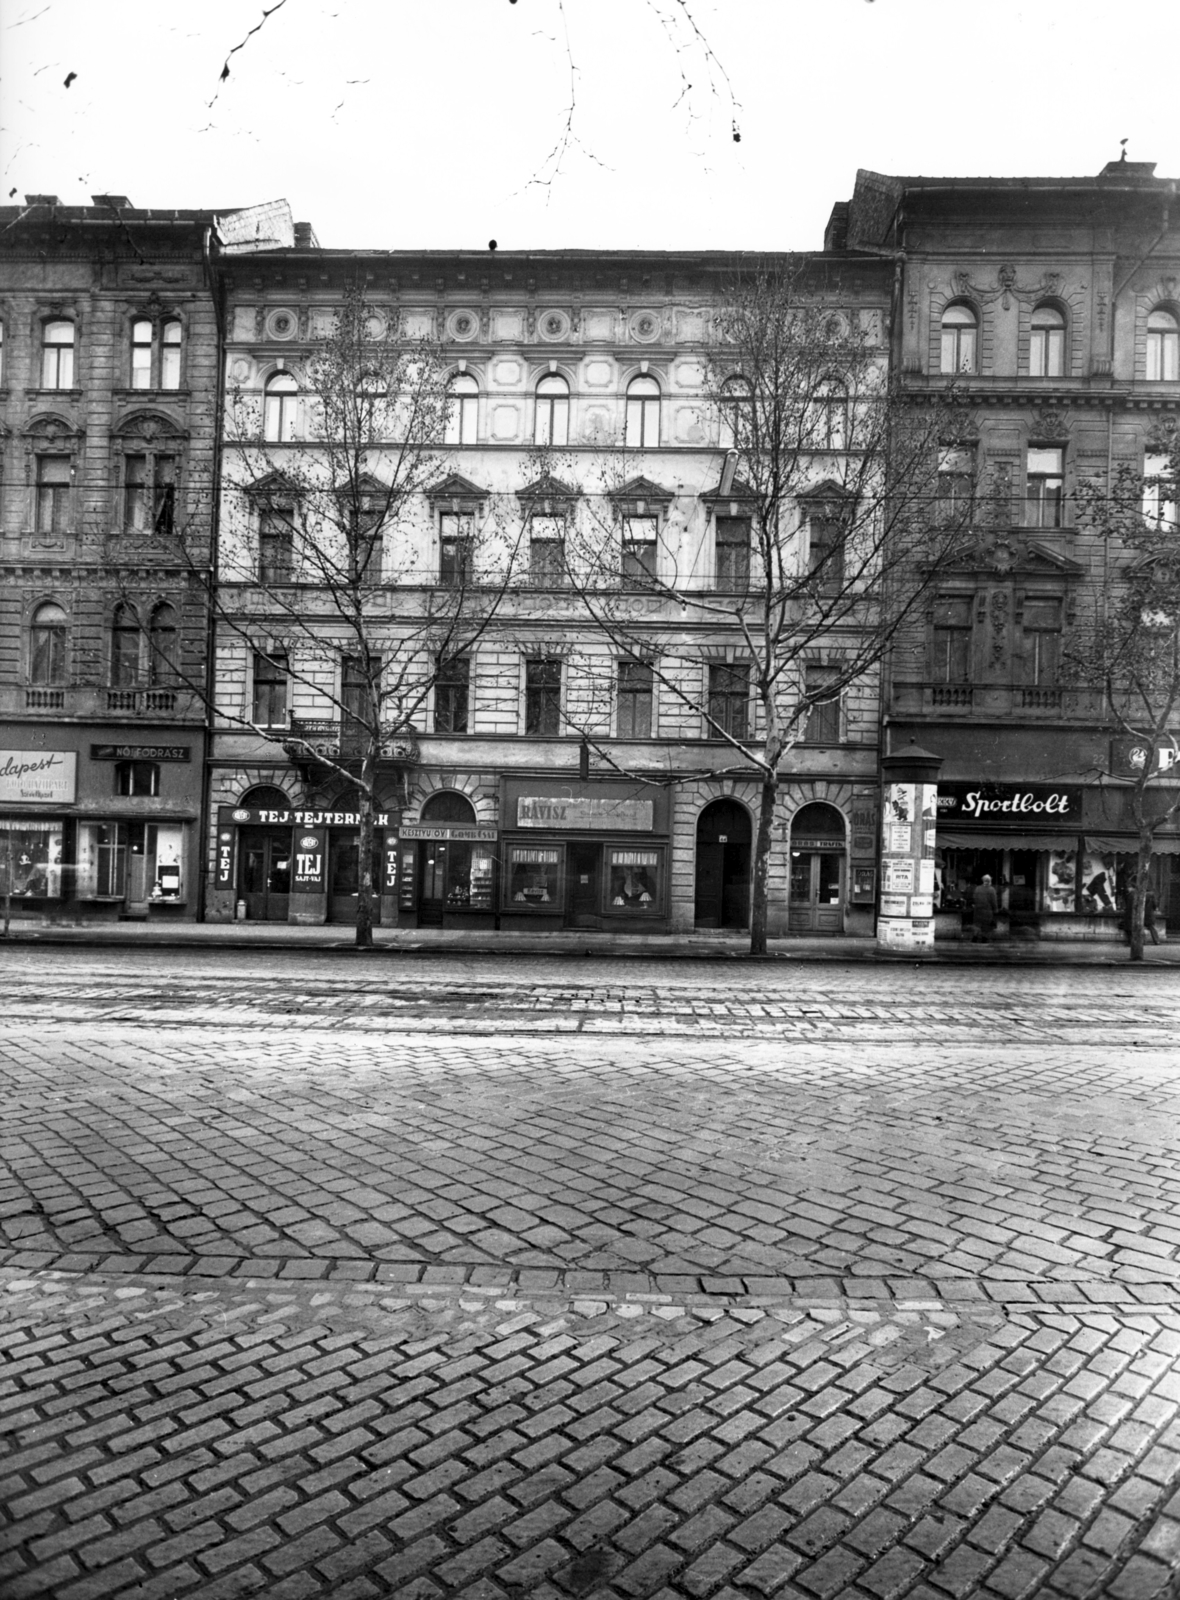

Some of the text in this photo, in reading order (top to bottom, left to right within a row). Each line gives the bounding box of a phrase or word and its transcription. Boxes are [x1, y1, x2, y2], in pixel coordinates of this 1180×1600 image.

[135, 747, 184, 759] FODRÁSZ
[961, 790, 1070, 817] Sportbolt
[259, 810, 290, 823] TEJ
[220, 846, 231, 881] TEJ
[296, 853, 322, 875] TEJ
[386, 851, 397, 886] TEJ
